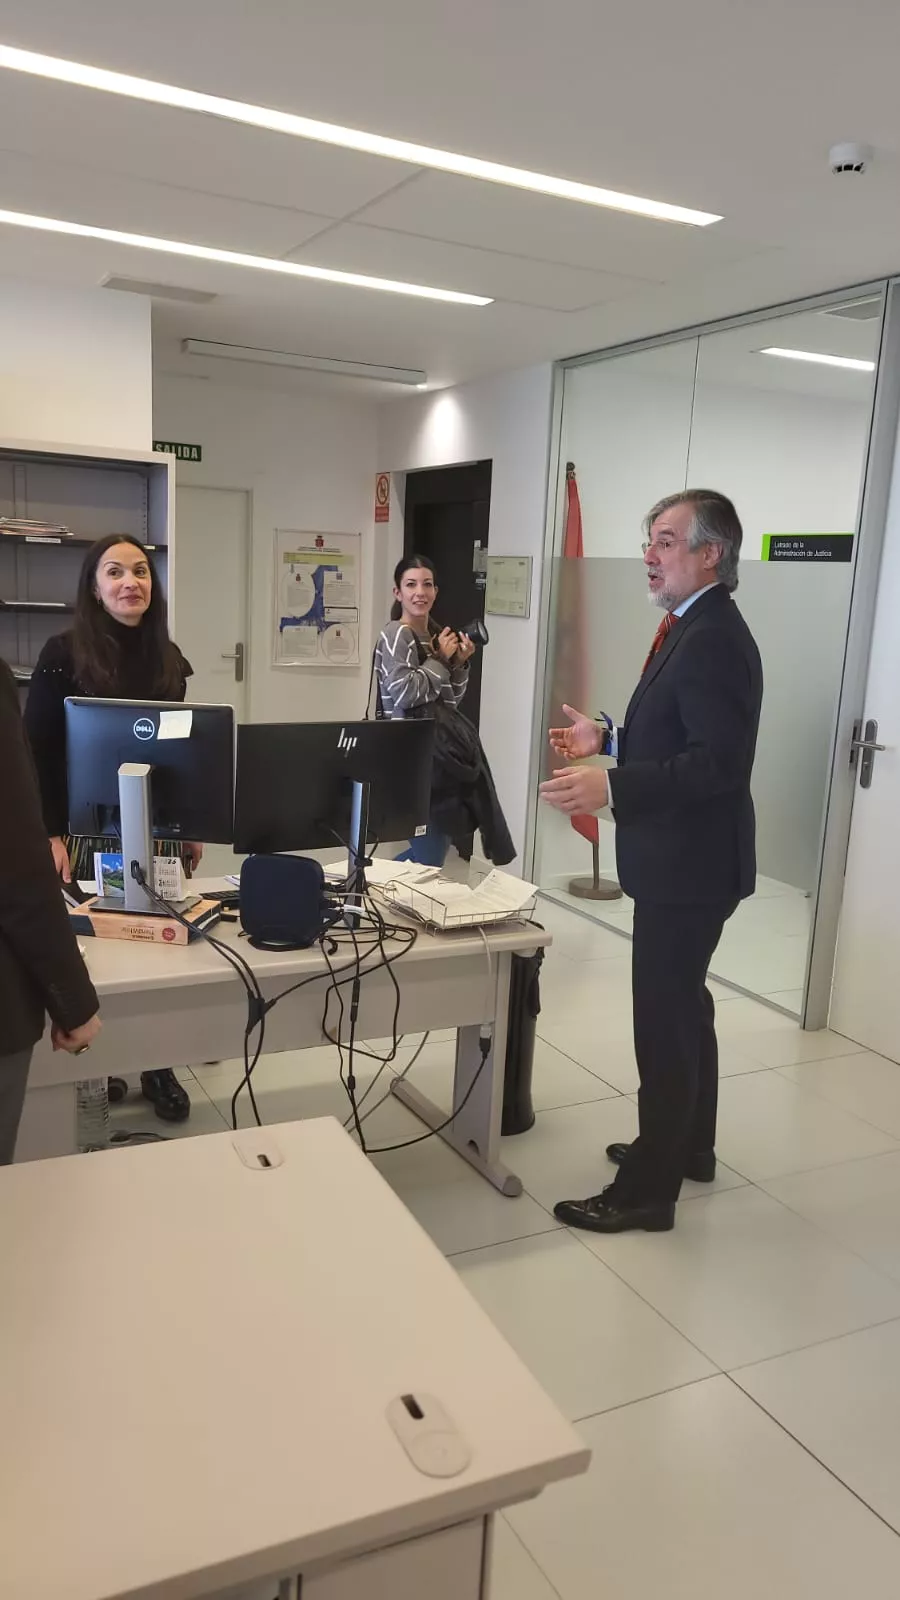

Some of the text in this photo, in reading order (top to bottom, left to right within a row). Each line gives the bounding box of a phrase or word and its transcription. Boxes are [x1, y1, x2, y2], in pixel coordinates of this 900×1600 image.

[814, 549, 832, 557] Justicia
[135, 725, 153, 733] DELL
[337, 727, 357, 758] hp
